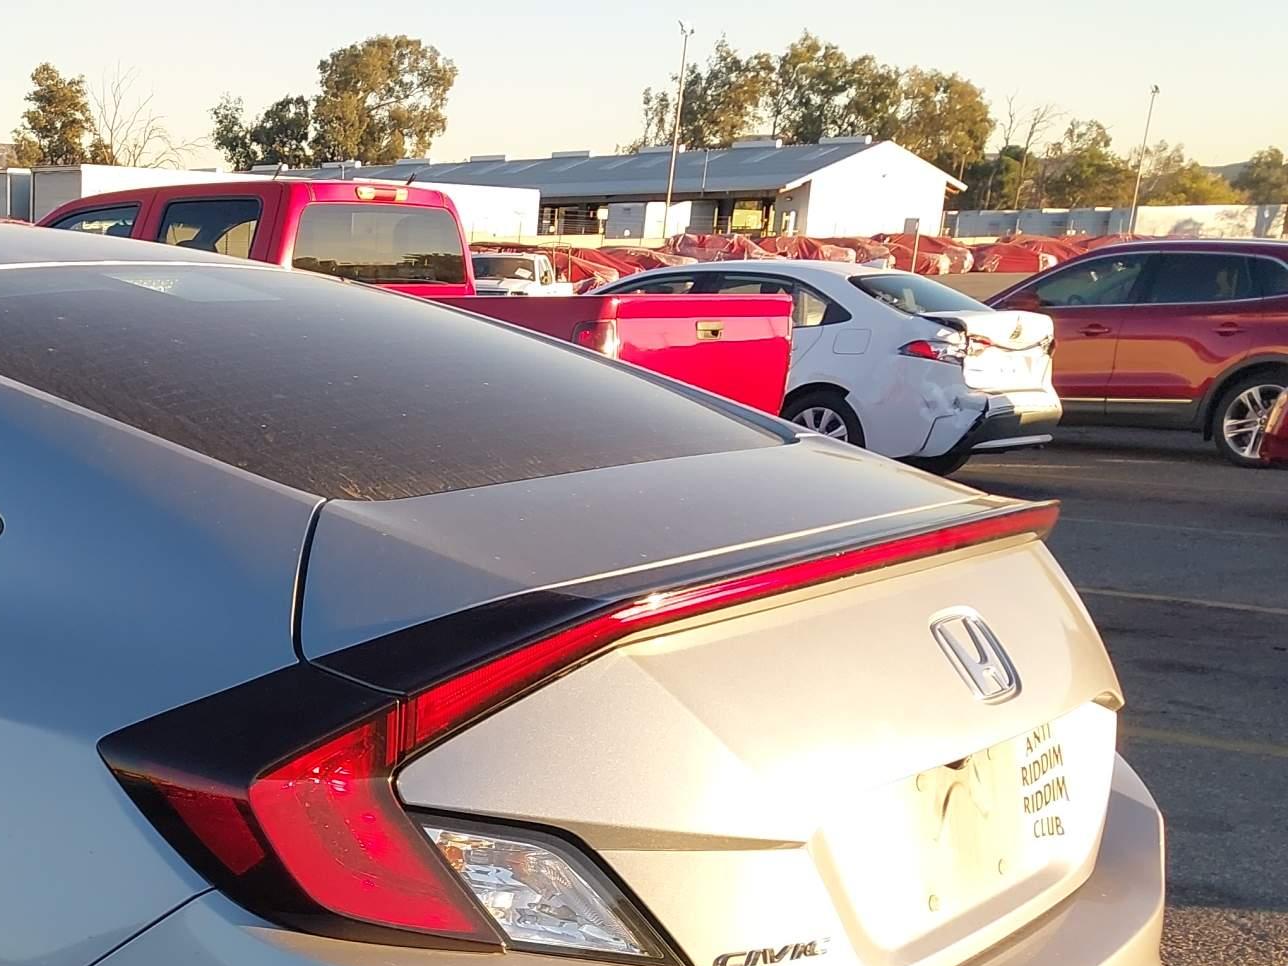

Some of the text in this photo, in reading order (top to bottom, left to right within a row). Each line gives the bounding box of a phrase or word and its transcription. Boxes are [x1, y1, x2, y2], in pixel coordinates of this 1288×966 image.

[1025, 722, 1052, 757] ANTI
[1020, 744, 1064, 787] RIDDIM
[1023, 776, 1069, 814] RIDDIM
[1033, 815, 1065, 839] CLUB
